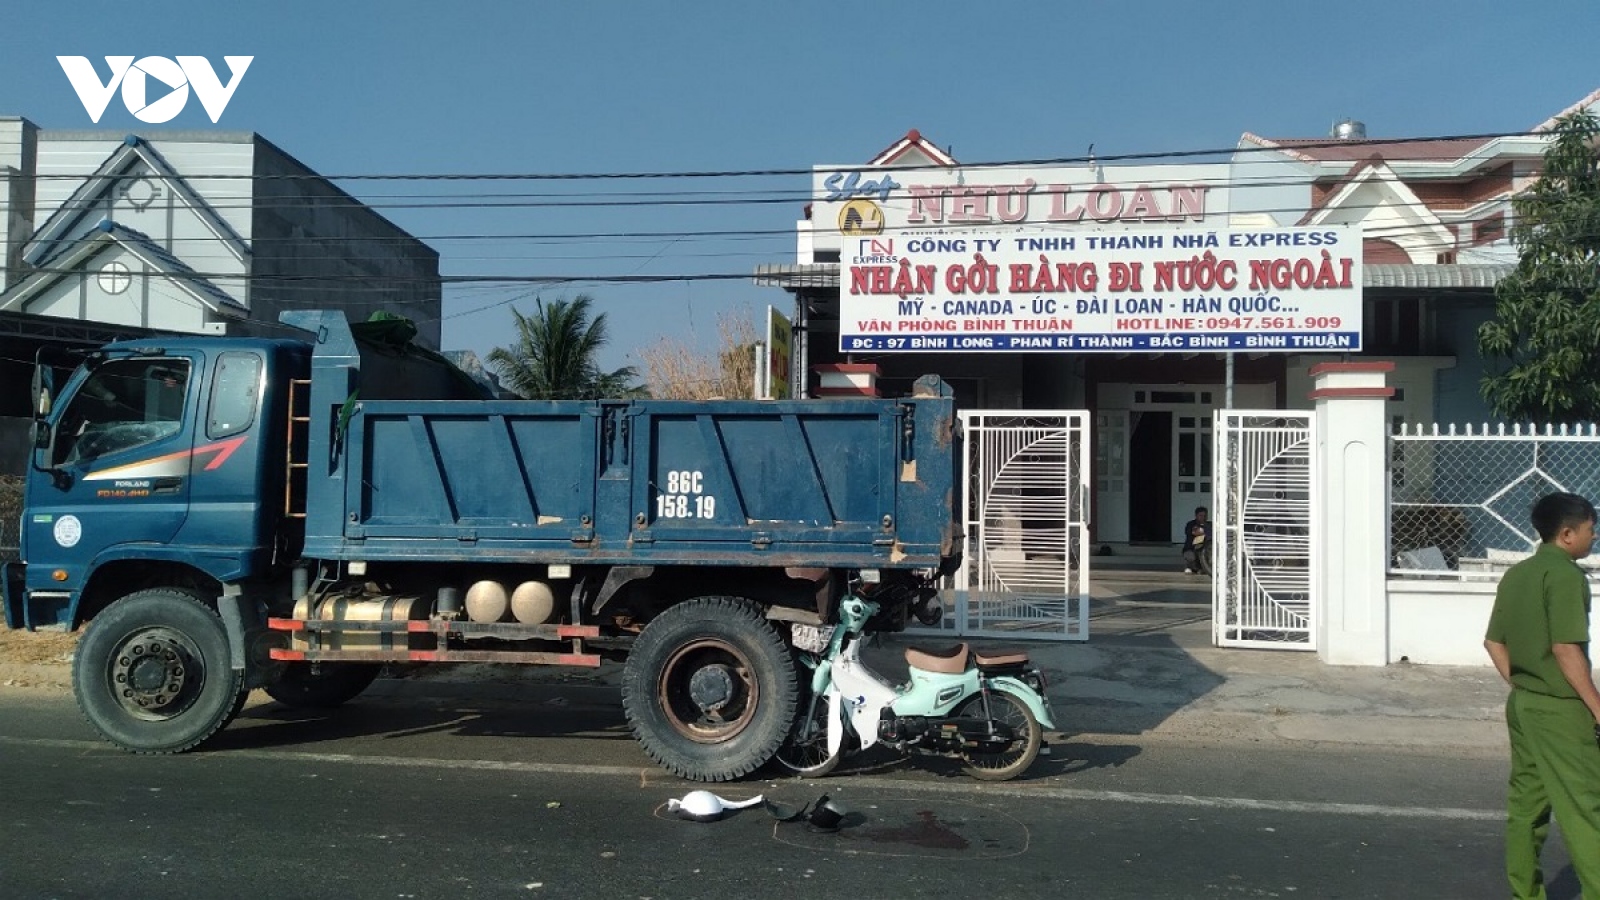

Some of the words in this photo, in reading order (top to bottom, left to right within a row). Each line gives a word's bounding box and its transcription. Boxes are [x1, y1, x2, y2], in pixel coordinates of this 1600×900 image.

[824, 172, 900, 203] Shop
[907, 178, 1037, 224] NHƯ
[1048, 182, 1210, 224] LOAN
[907, 237, 967, 253] CÔNG
[973, 239, 1001, 252] TY
[1014, 237, 1076, 251] TNHH
[1085, 235, 1164, 250] THANH
[1228, 231, 1339, 247] EXPRESS
[852, 255, 898, 265] EXPRESS
[849, 256, 938, 300] NHẬN
[1008, 253, 1100, 293] HÀNG
[1107, 261, 1144, 293] ĐI
[1153, 249, 1238, 292] NƯỚC
[1248, 248, 1354, 291] NGOÀI
[898, 297, 925, 316] MỸ
[943, 300, 1013, 316] CANADA
[1032, 295, 1056, 315] ÚC
[1076, 295, 1108, 314] ĐÀI
[1114, 298, 1164, 314] LOAN
[1182, 294, 1222, 313] HÀN
[898, 317, 957, 332] PHÒNG
[963, 317, 1006, 331] BÌNH
[852, 338, 873, 349] ĐC
[887, 338, 906, 349] 97
[911, 335, 948, 349] BÌNH
[952, 338, 993, 348] LONG
[1010, 337, 1053, 348] PHAN
[1057, 335, 1074, 348] RÍ
[1079, 334, 1133, 348] THÀNH
[1189, 334, 1229, 347] BÌNH
[1246, 334, 1286, 347] BÌNH
[1292, 332, 1350, 349] THUẬN
[667, 470, 703, 494] 86C
[656, 495, 715, 519] 158.19
